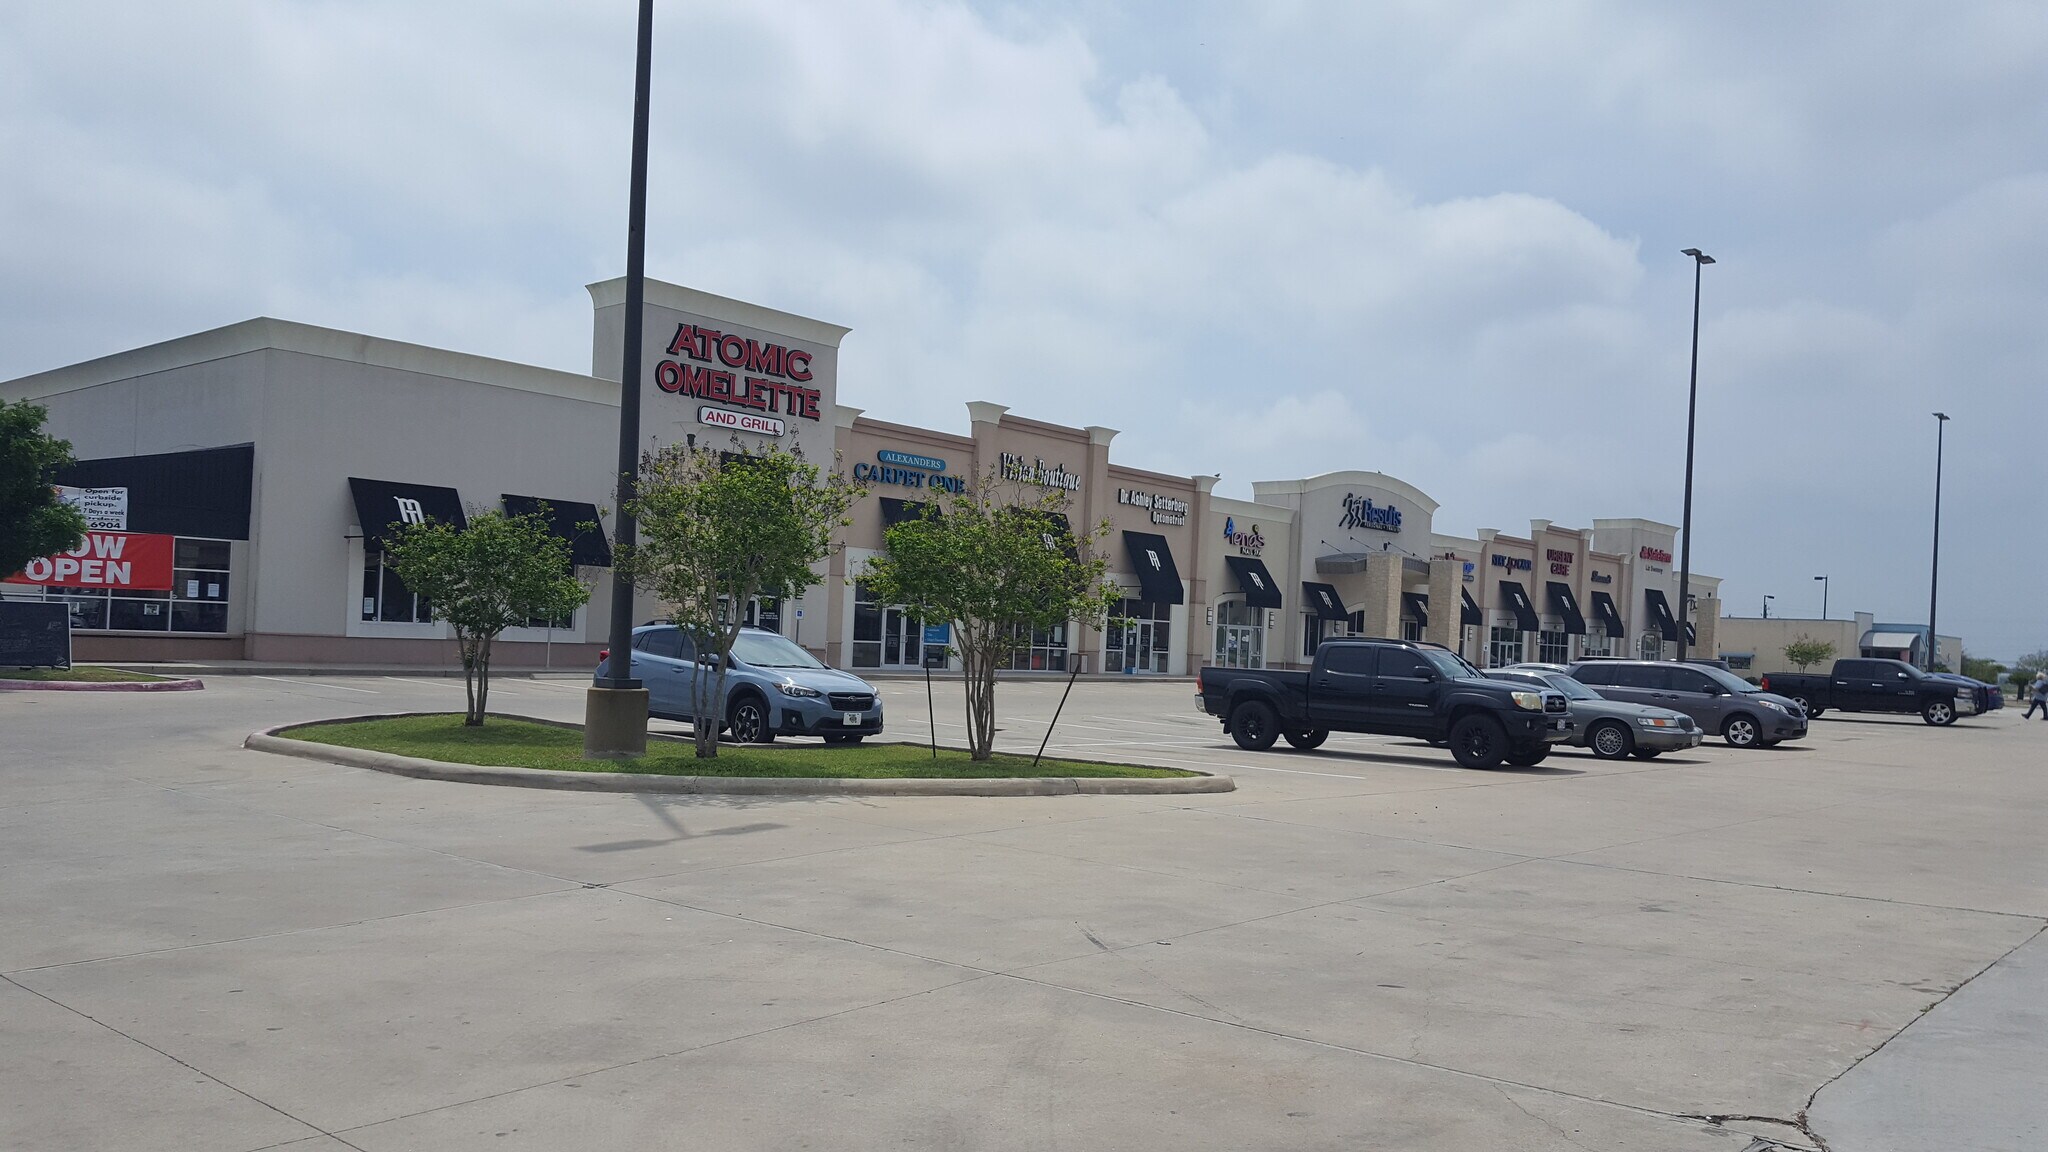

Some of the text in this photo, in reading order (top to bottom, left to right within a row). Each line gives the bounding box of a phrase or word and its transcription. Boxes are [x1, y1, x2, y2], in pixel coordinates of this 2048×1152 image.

[666, 322, 814, 382] ATOMIC
[655, 359, 821, 422] OMELETTE
[705, 411, 780, 435] AND GRILL
[885, 452, 942, 469] ALEXANDERS
[854, 462, 966, 494] CARPET ONE
[1036, 458, 1081, 498] Boutique
[85, 487, 125, 495] Open for
[1118, 488, 1189, 516] Dr. Ashley Setterberg
[88, 508, 103, 516] Days
[1151, 511, 1185, 526] Optometrist
[1360, 498, 1403, 527] Results
[64, 534, 127, 559] OW
[1547, 549, 1574, 564] URGENT
[25, 557, 131, 585] OPEN
[1550, 562, 1570, 577] CARE
